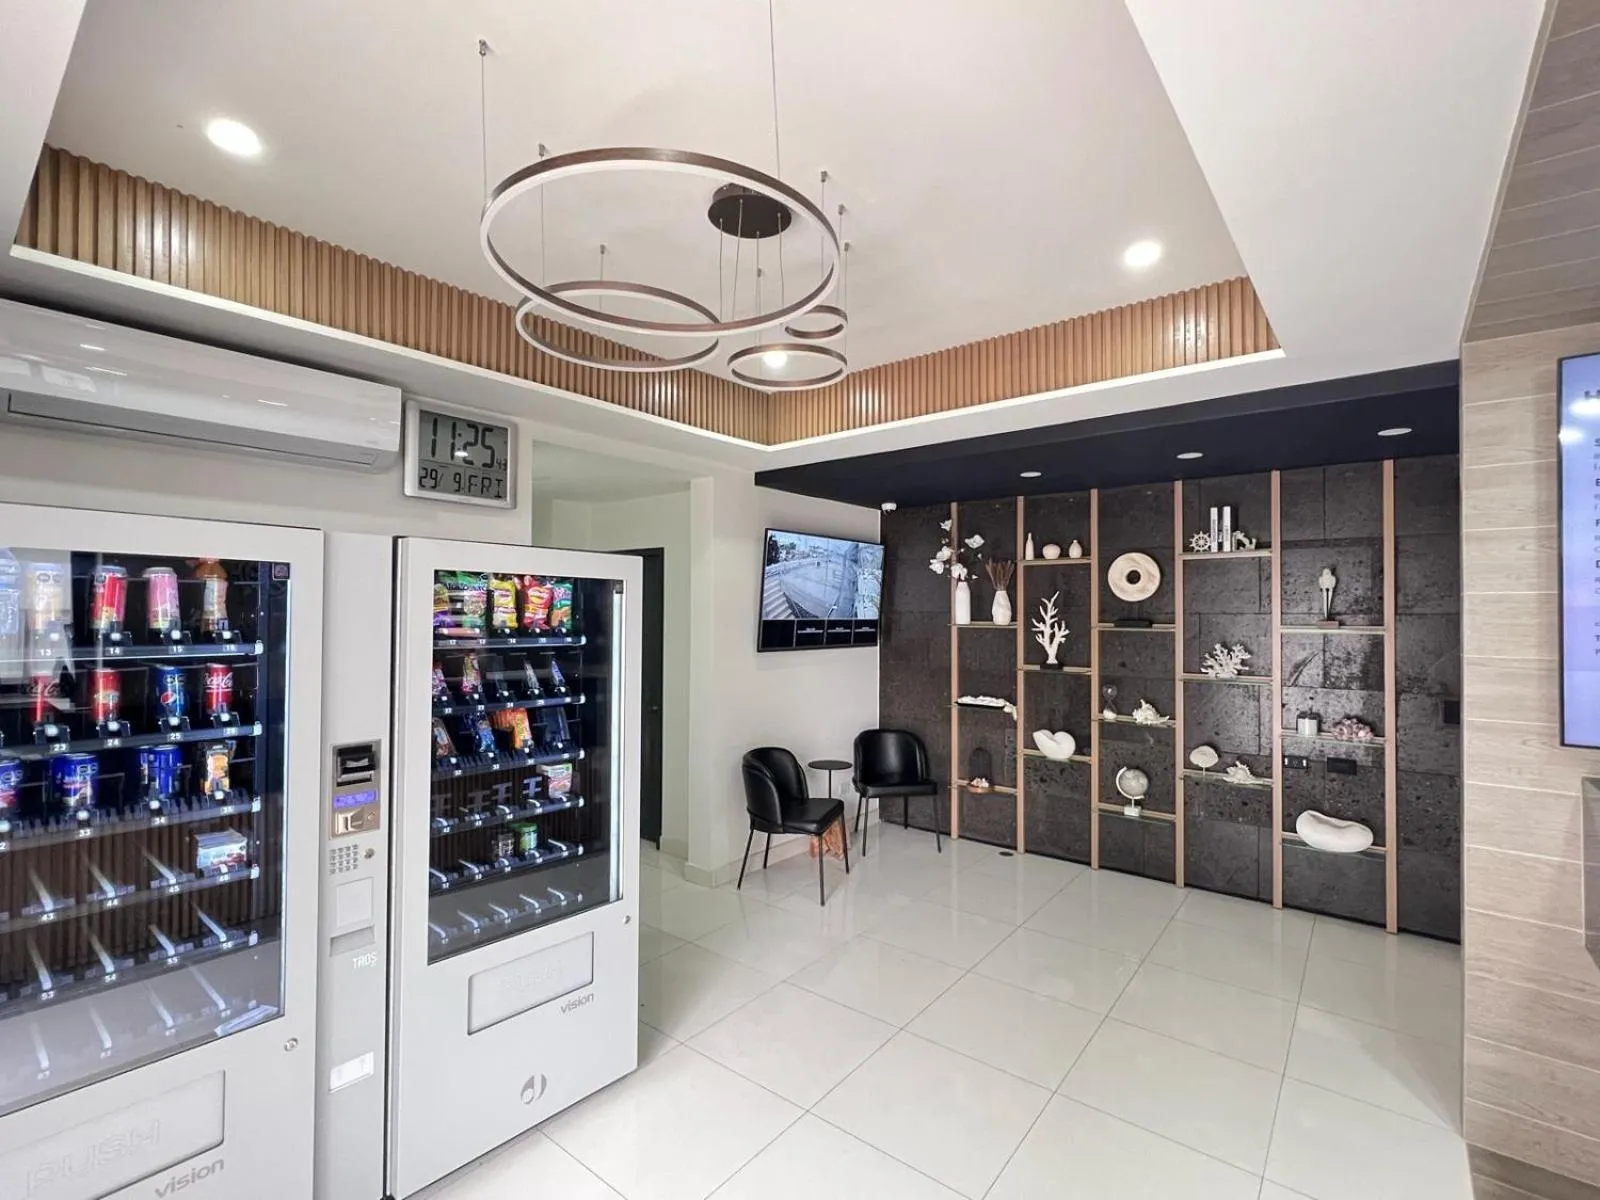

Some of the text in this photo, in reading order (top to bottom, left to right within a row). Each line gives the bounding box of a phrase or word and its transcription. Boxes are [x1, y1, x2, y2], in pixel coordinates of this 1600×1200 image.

[431, 418, 495, 468] 11:25
[468, 475, 503, 498] FRI
[54, 743, 67, 752] 23
[559, 992, 595, 1014] vision
[154, 1158, 224, 1199] vision
